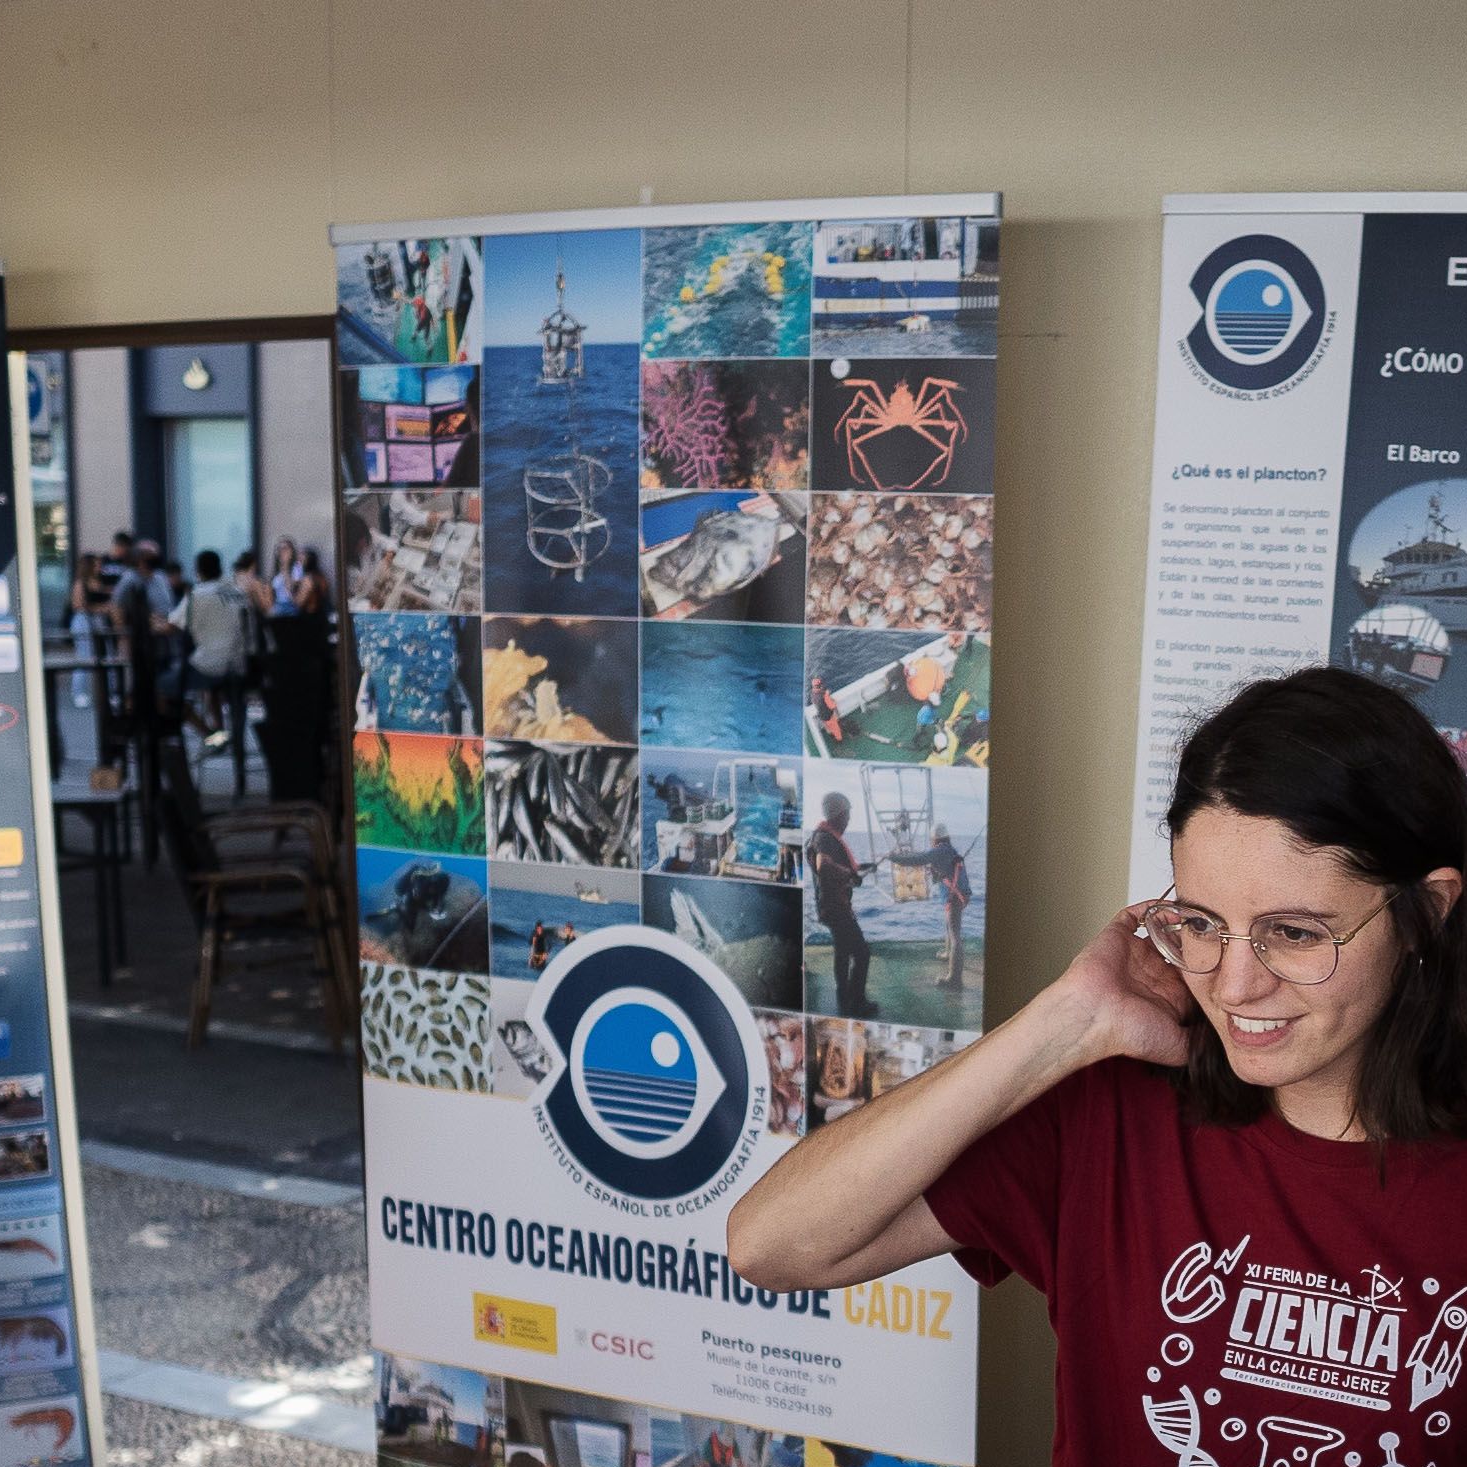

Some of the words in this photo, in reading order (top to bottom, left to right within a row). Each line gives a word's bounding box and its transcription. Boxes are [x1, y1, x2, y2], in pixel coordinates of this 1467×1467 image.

[1388, 444, 1404, 461] El
[1409, 445, 1460, 464] Barco
[1172, 464, 1210, 480] ¿Qué
[1216, 467, 1231, 479] es
[1237, 467, 1250, 479] el
[1254, 467, 1327, 483] plancton?
[1180, 504, 1228, 515] denomina
[1232, 505, 1273, 518] plancton
[1277, 506, 1285, 516] al
[1289, 508, 1330, 520] conjunto
[534, 1104, 582, 1184] INSTITUTO
[584, 1182, 649, 1218] ESPAÑOL
[654, 1206, 672, 1217] DE
[676, 1128, 760, 1216] OCEANOGRAFÍA
[752, 1086, 766, 1122] 1914
[382, 1195, 496, 1258] CENTRO
[1245, 1263, 1260, 1278] XI
[1264, 1265, 1303, 1286] FERIA
[1306, 1273, 1328, 1289] DE
[1331, 1279, 1351, 1295] LA
[591, 1332, 655, 1360] CSIC
[1229, 1287, 1400, 1372] CIENCIA
[701, 1330, 755, 1354] Puerto
[761, 1345, 842, 1369] pesquero
[707, 1351, 741, 1369] Muelle
[745, 1360, 759, 1372] de
[762, 1363, 813, 1382] Levante,
[818, 1371, 837, 1386] s/n
[1224, 1350, 1245, 1366] EN
[1247, 1355, 1265, 1370] LA
[1270, 1360, 1319, 1381] CALLE
[1321, 1371, 1339, 1386] DE
[1342, 1376, 1390, 1395] JEREZ
